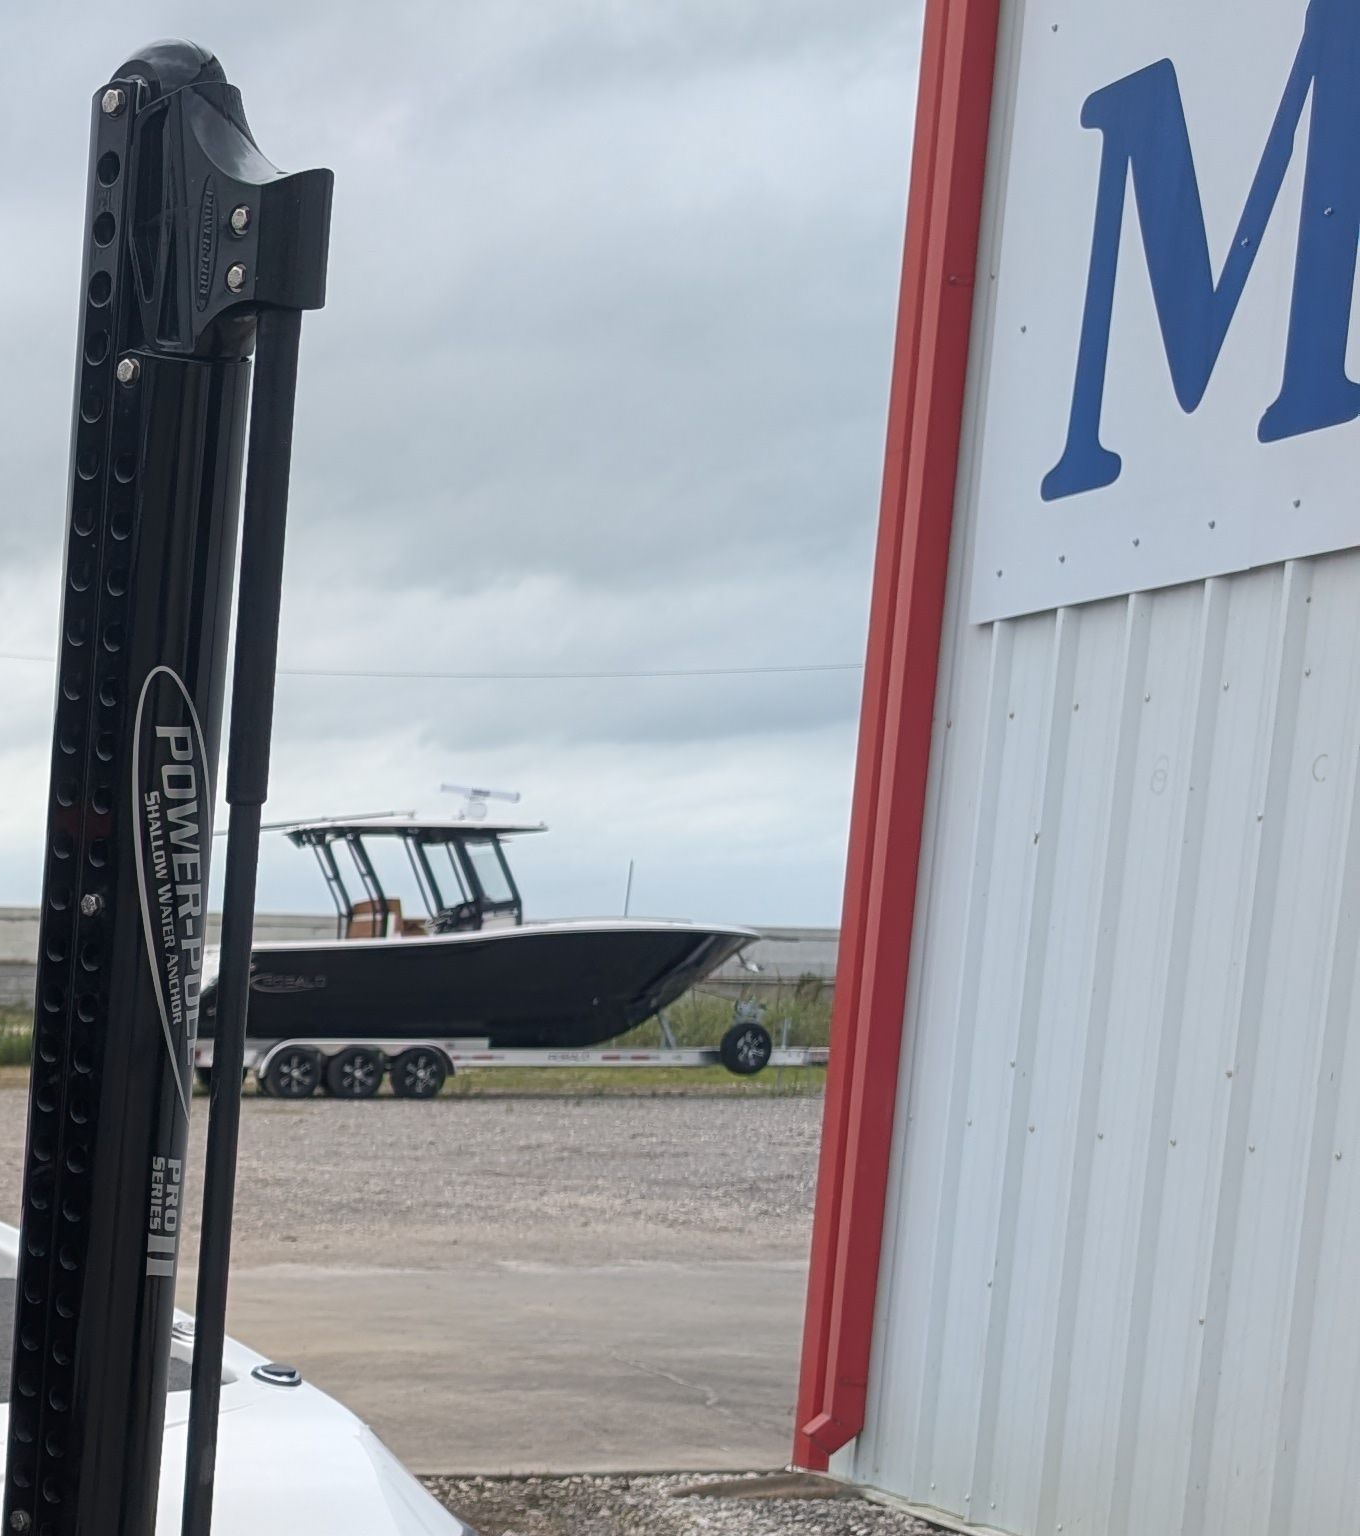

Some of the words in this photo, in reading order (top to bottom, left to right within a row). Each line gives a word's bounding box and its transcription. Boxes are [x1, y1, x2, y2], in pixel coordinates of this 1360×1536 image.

[144, 790, 168, 879] SHALLOW
[156, 884, 176, 949] WATER
[165, 952, 182, 1025] ANCHOR
[149, 1156, 166, 1231] SERIES
[165, 1158, 182, 1232] PRO
